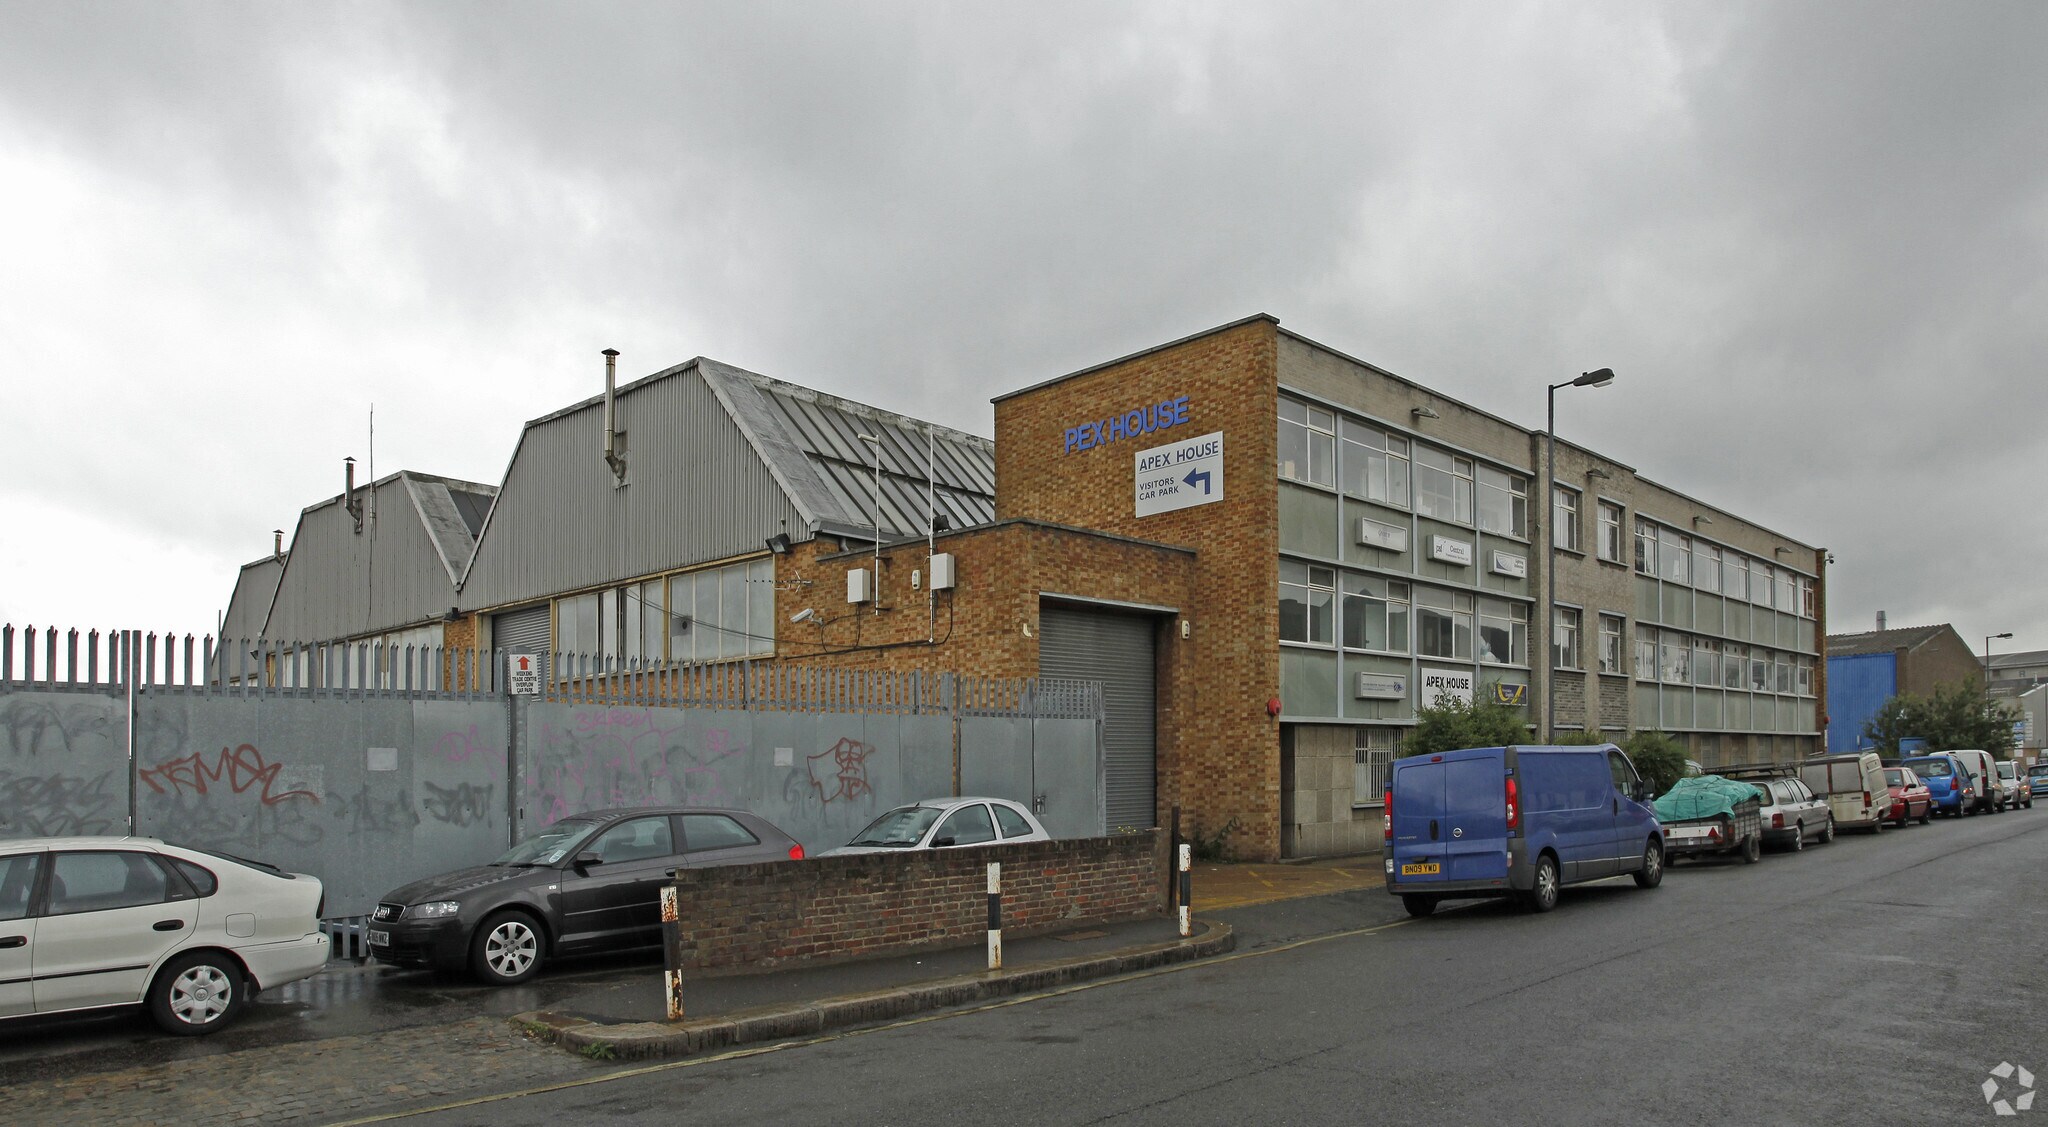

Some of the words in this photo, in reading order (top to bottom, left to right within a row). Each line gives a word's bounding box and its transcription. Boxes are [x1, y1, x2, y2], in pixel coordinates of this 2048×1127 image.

[1065, 419, 1106, 454] PEX
[1109, 395, 1190, 442] HOUSE
[1139, 453, 1171, 472] APEX
[1176, 441, 1219, 463] HOUSE
[1139, 477, 1175, 490] VISITORS
[1139, 489, 1156, 501] CAR
[1158, 485, 1179, 497] PARK
[1426, 676, 1445, 688] APEX
[1446, 677, 1469, 689] HOUSE
[1404, 865, 1422, 874] BN09
